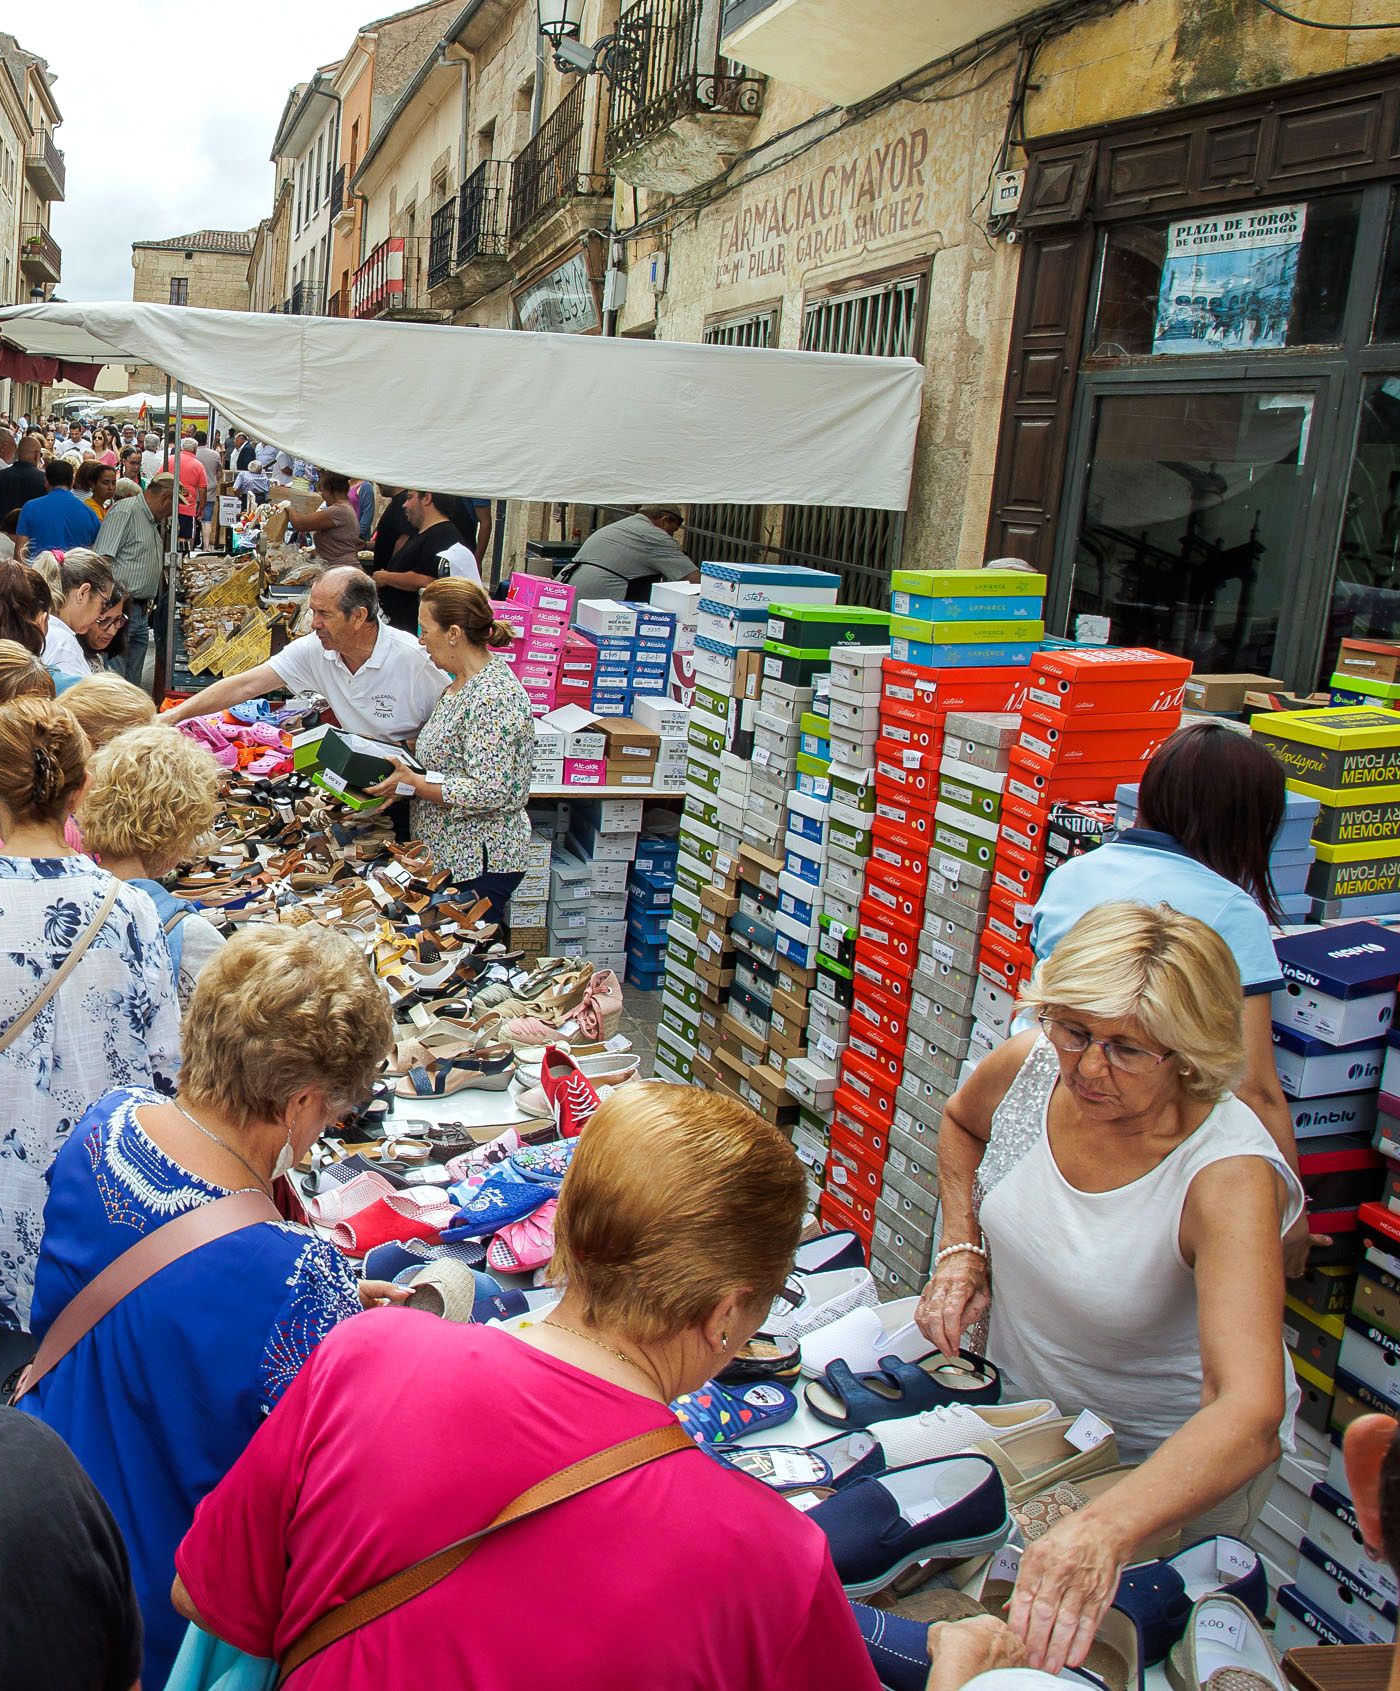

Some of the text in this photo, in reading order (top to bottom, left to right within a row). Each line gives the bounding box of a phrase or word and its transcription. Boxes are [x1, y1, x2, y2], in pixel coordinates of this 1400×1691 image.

[718, 179, 817, 259] FARMACIA
[1176, 211, 1298, 237] PLAZA DE TOROS
[747, 244, 786, 279] PILAR
[796, 221, 847, 263] GARCIA
[853, 192, 924, 246] SANCHEZ
[1176, 224, 1298, 247] DE CIUDAD RODRIGO
[543, 586, 568, 596] Alcalde
[500, 613, 524, 621] Alcalde
[537, 613, 561, 621] Alcalde
[531, 639, 555, 648] Alcalde
[525, 665, 548, 673] Alcalde
[573, 762, 598, 771] Alcalde
[1343, 754, 1384, 770] FOAM
[1341, 767, 1400, 784] MEMORY
[1340, 809, 1381, 825] FOAM
[1339, 824, 1400, 840] MEMORY
[1336, 865, 1376, 882] FOAM
[1334, 877, 1395, 896] MEMORY
[1282, 963, 1320, 986] inblu
[1312, 1110, 1356, 1125] inblu
[1336, 1569, 1370, 1600] inblu
[1228, 1623, 1238, 1635] €
[1317, 1619, 1345, 1646] inbl
